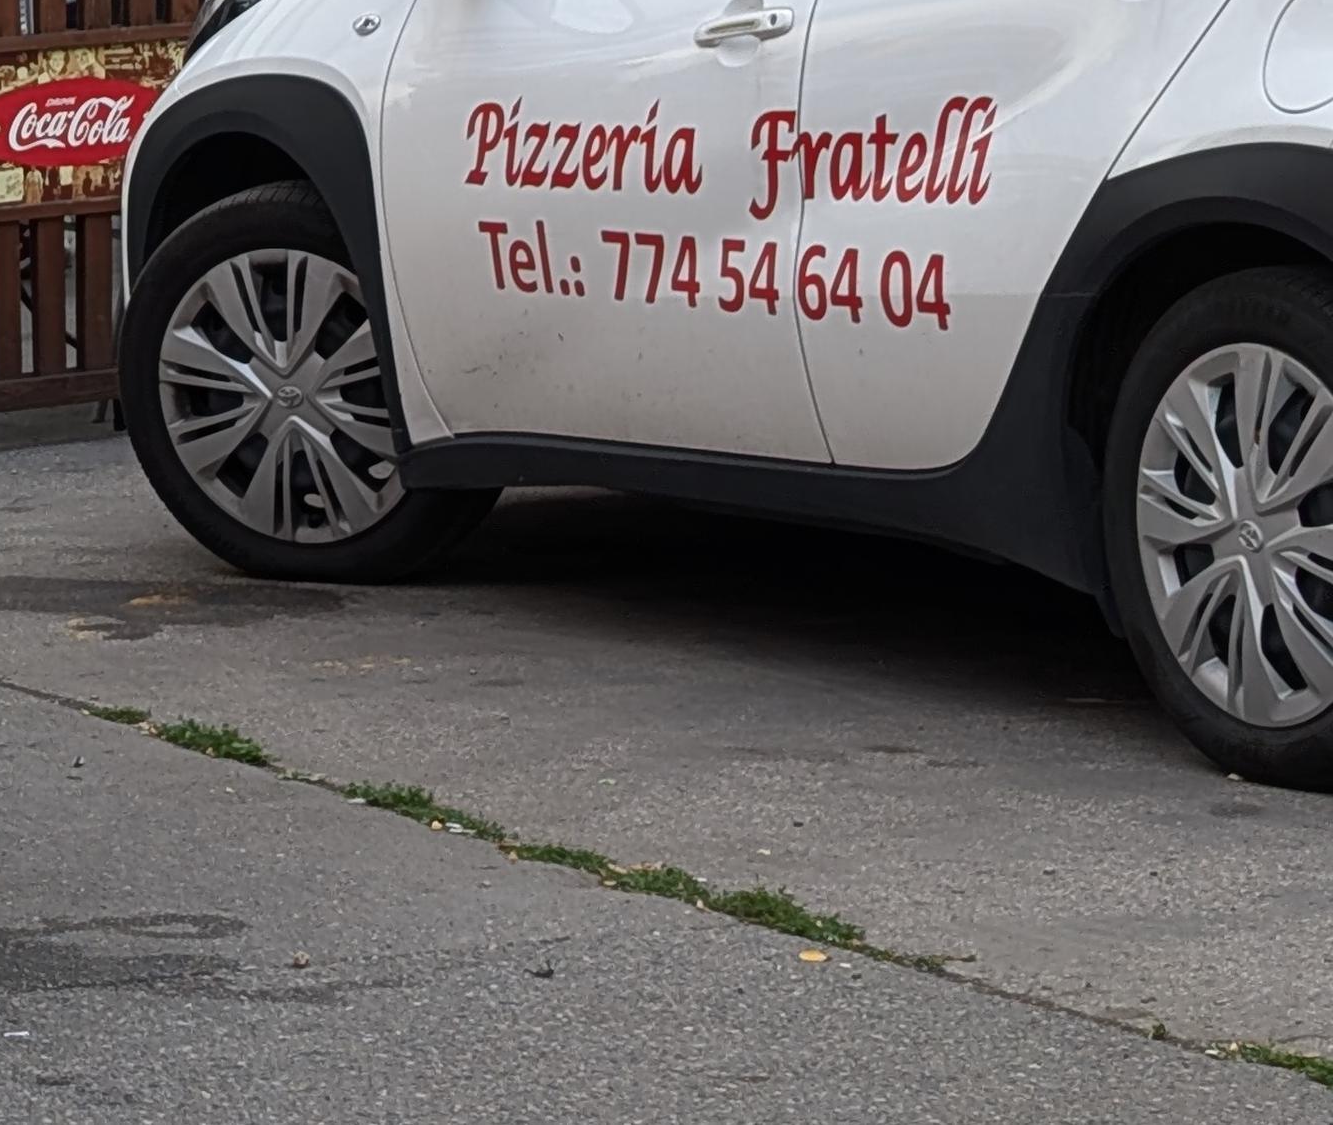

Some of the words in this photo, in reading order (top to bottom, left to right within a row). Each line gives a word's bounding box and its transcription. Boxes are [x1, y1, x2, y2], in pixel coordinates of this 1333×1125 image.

[9, 94, 135, 152] Coca-Cola
[465, 95, 703, 194] Pizzeria
[749, 96, 999, 220] Fratelli
[478, 220, 586, 298] Tel.:
[601, 229, 700, 309] 774
[717, 238, 779, 316] 54
[798, 244, 863, 324] 64
[879, 250, 952, 331] 04
